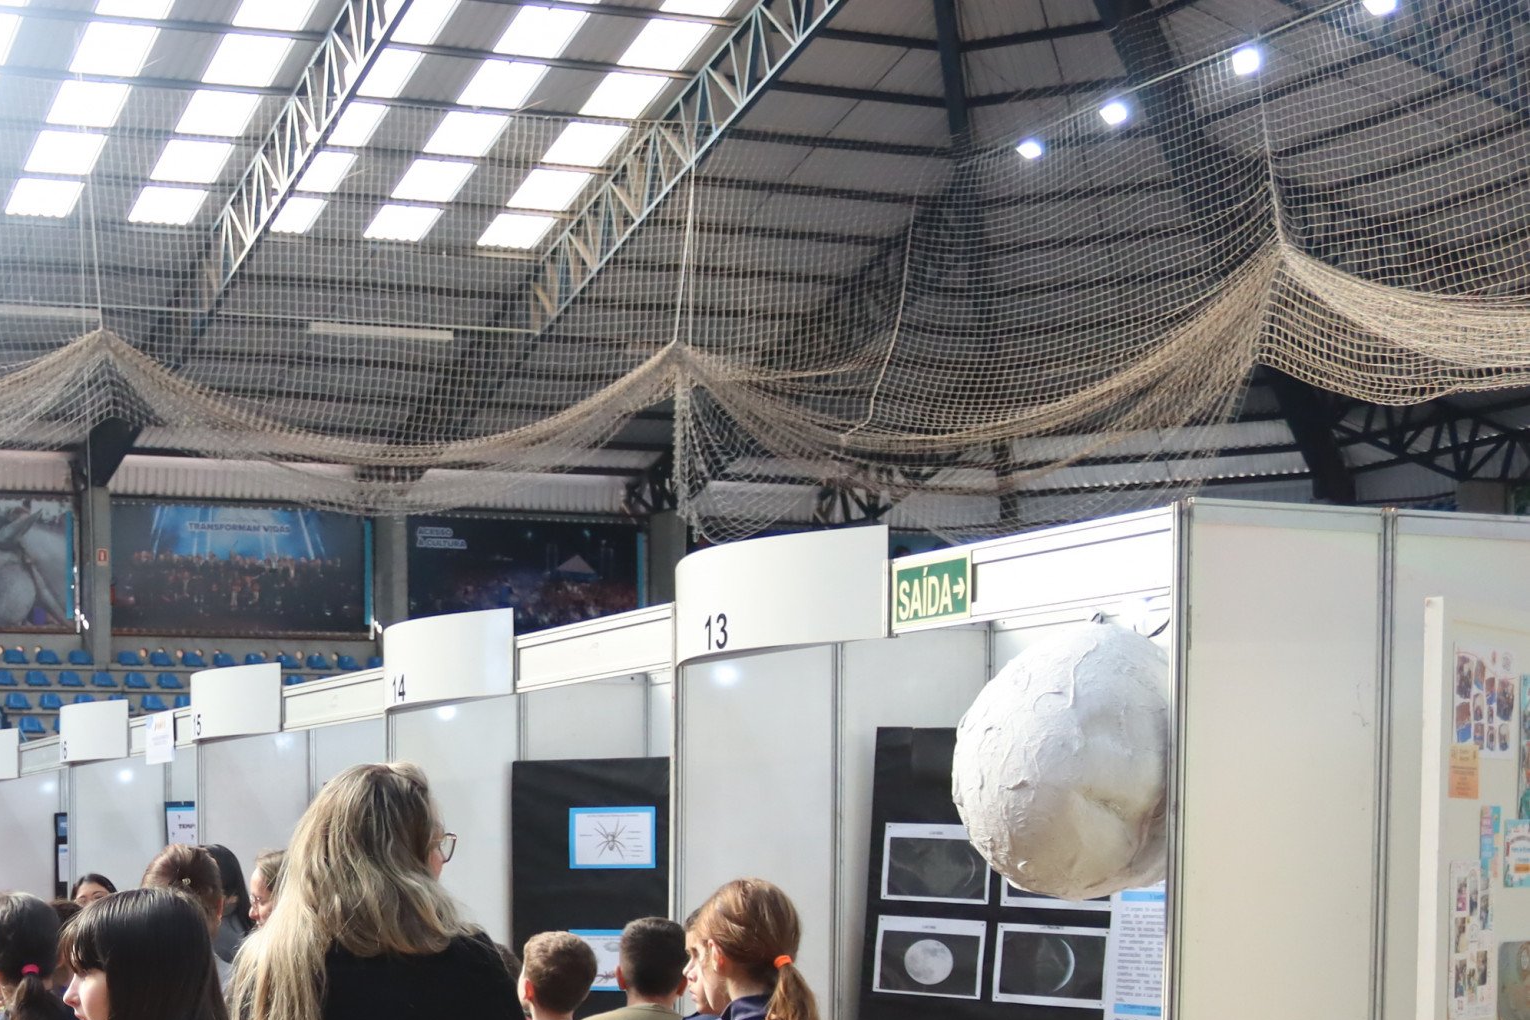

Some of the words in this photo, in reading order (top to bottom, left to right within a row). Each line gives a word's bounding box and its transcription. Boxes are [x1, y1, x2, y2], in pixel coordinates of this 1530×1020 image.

[898, 566, 953, 620] SAÍDA
[704, 613, 729, 650] 13
[392, 674, 406, 702] 14
